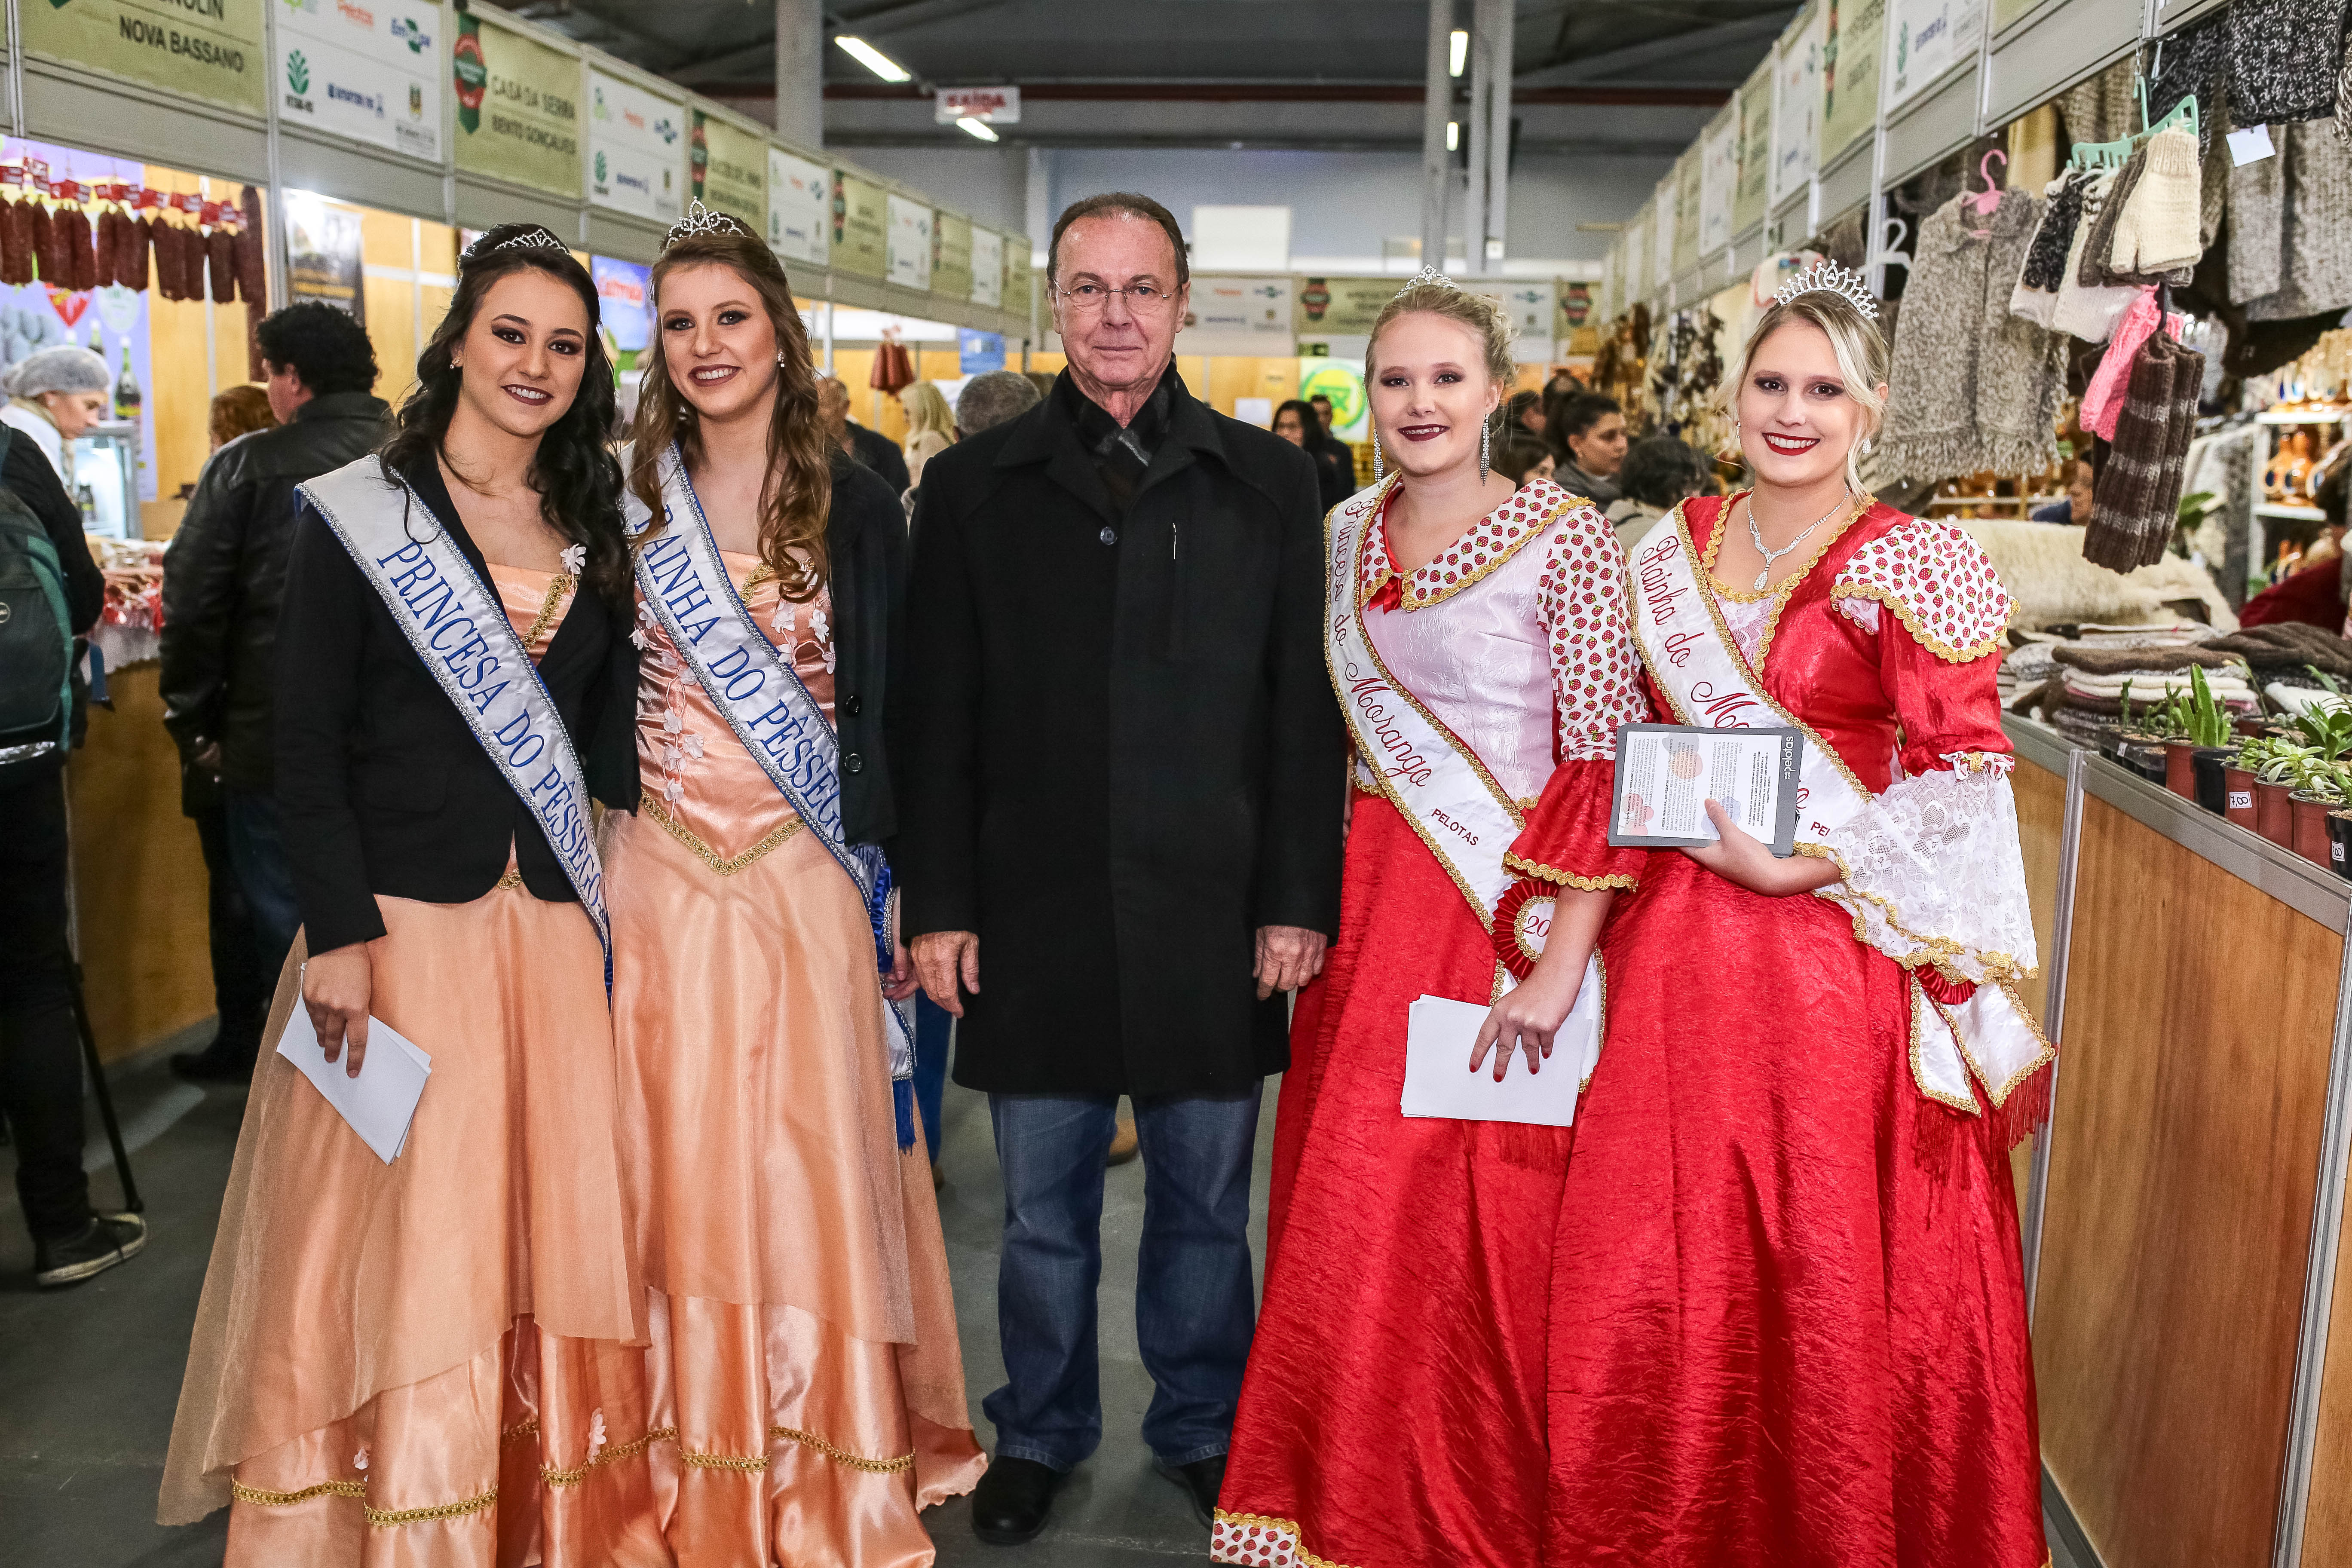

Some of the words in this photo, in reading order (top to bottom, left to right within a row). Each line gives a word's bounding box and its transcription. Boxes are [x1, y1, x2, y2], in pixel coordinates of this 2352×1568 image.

[120, 15, 166, 51] NOVA
[169, 30, 244, 72] BASSANO
[1335, 497, 1377, 601] Princesa
[1640, 536, 1689, 625] Rainha
[1665, 632, 1705, 668] do
[1335, 615, 1351, 646] do
[707, 646, 766, 700] DO
[376, 537, 512, 715] PRINCESA
[493, 709, 544, 768] DO
[530, 763, 601, 907] PÊSSEGO
[1345, 662, 1431, 787] Morango
[1782, 736, 1796, 772] pelotas
[1431, 808, 1478, 846] PELOTAS
[2230, 796, 2248, 807] 7,00
